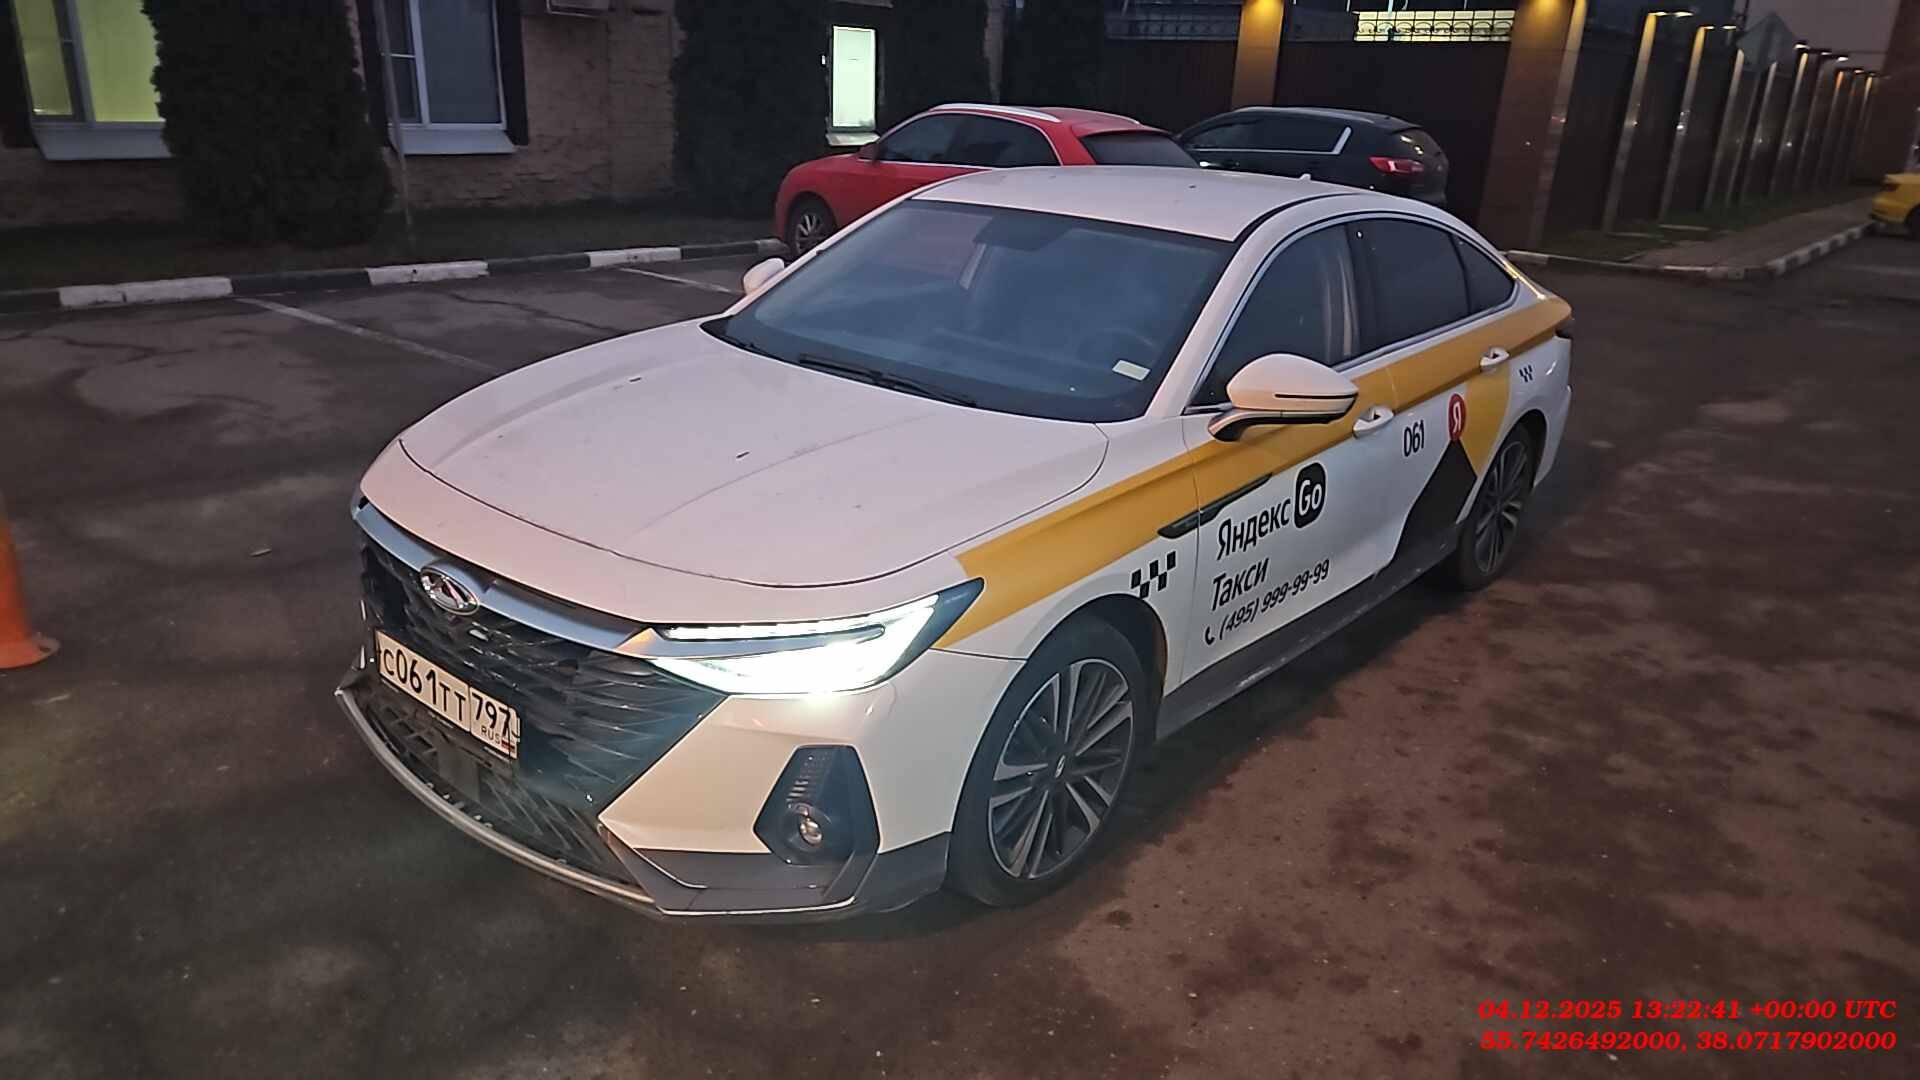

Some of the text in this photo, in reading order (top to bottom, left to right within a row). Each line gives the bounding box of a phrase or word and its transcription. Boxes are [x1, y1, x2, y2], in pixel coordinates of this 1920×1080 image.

[1403, 419, 1426, 458] 061
[1216, 498, 1291, 561] Яндекс
[1212, 558, 1270, 612] Такси
[1219, 559, 1330, 640] (495) 999-99-99
[481, 725, 501, 745] RUS
